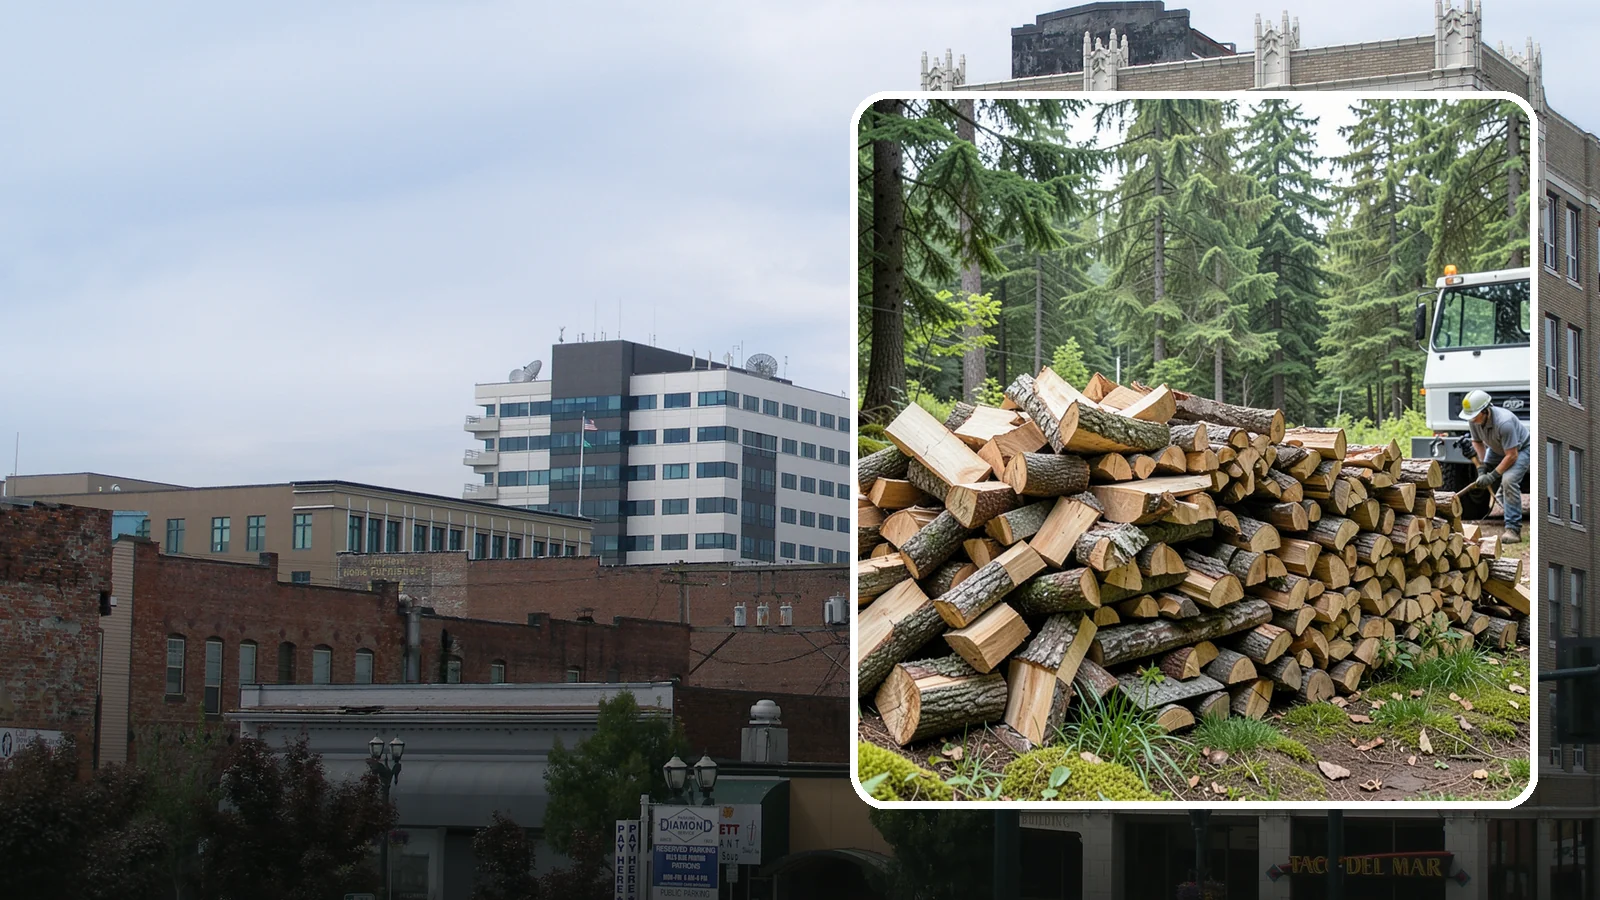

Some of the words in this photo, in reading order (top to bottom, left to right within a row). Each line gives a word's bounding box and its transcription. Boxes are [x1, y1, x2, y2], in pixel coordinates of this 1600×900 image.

[661, 818, 713, 832] DIAMOND
[1022, 815, 1070, 828] BUILDING
[690, 846, 716, 854] PARKING
[722, 852, 739, 862] Soup
[1346, 856, 1384, 876] DEL
[1392, 857, 1442, 877] MAR
[628, 856, 636, 893] HERE
[660, 889, 682, 897] PUBLIC
[684, 890, 710, 898] PARKING
